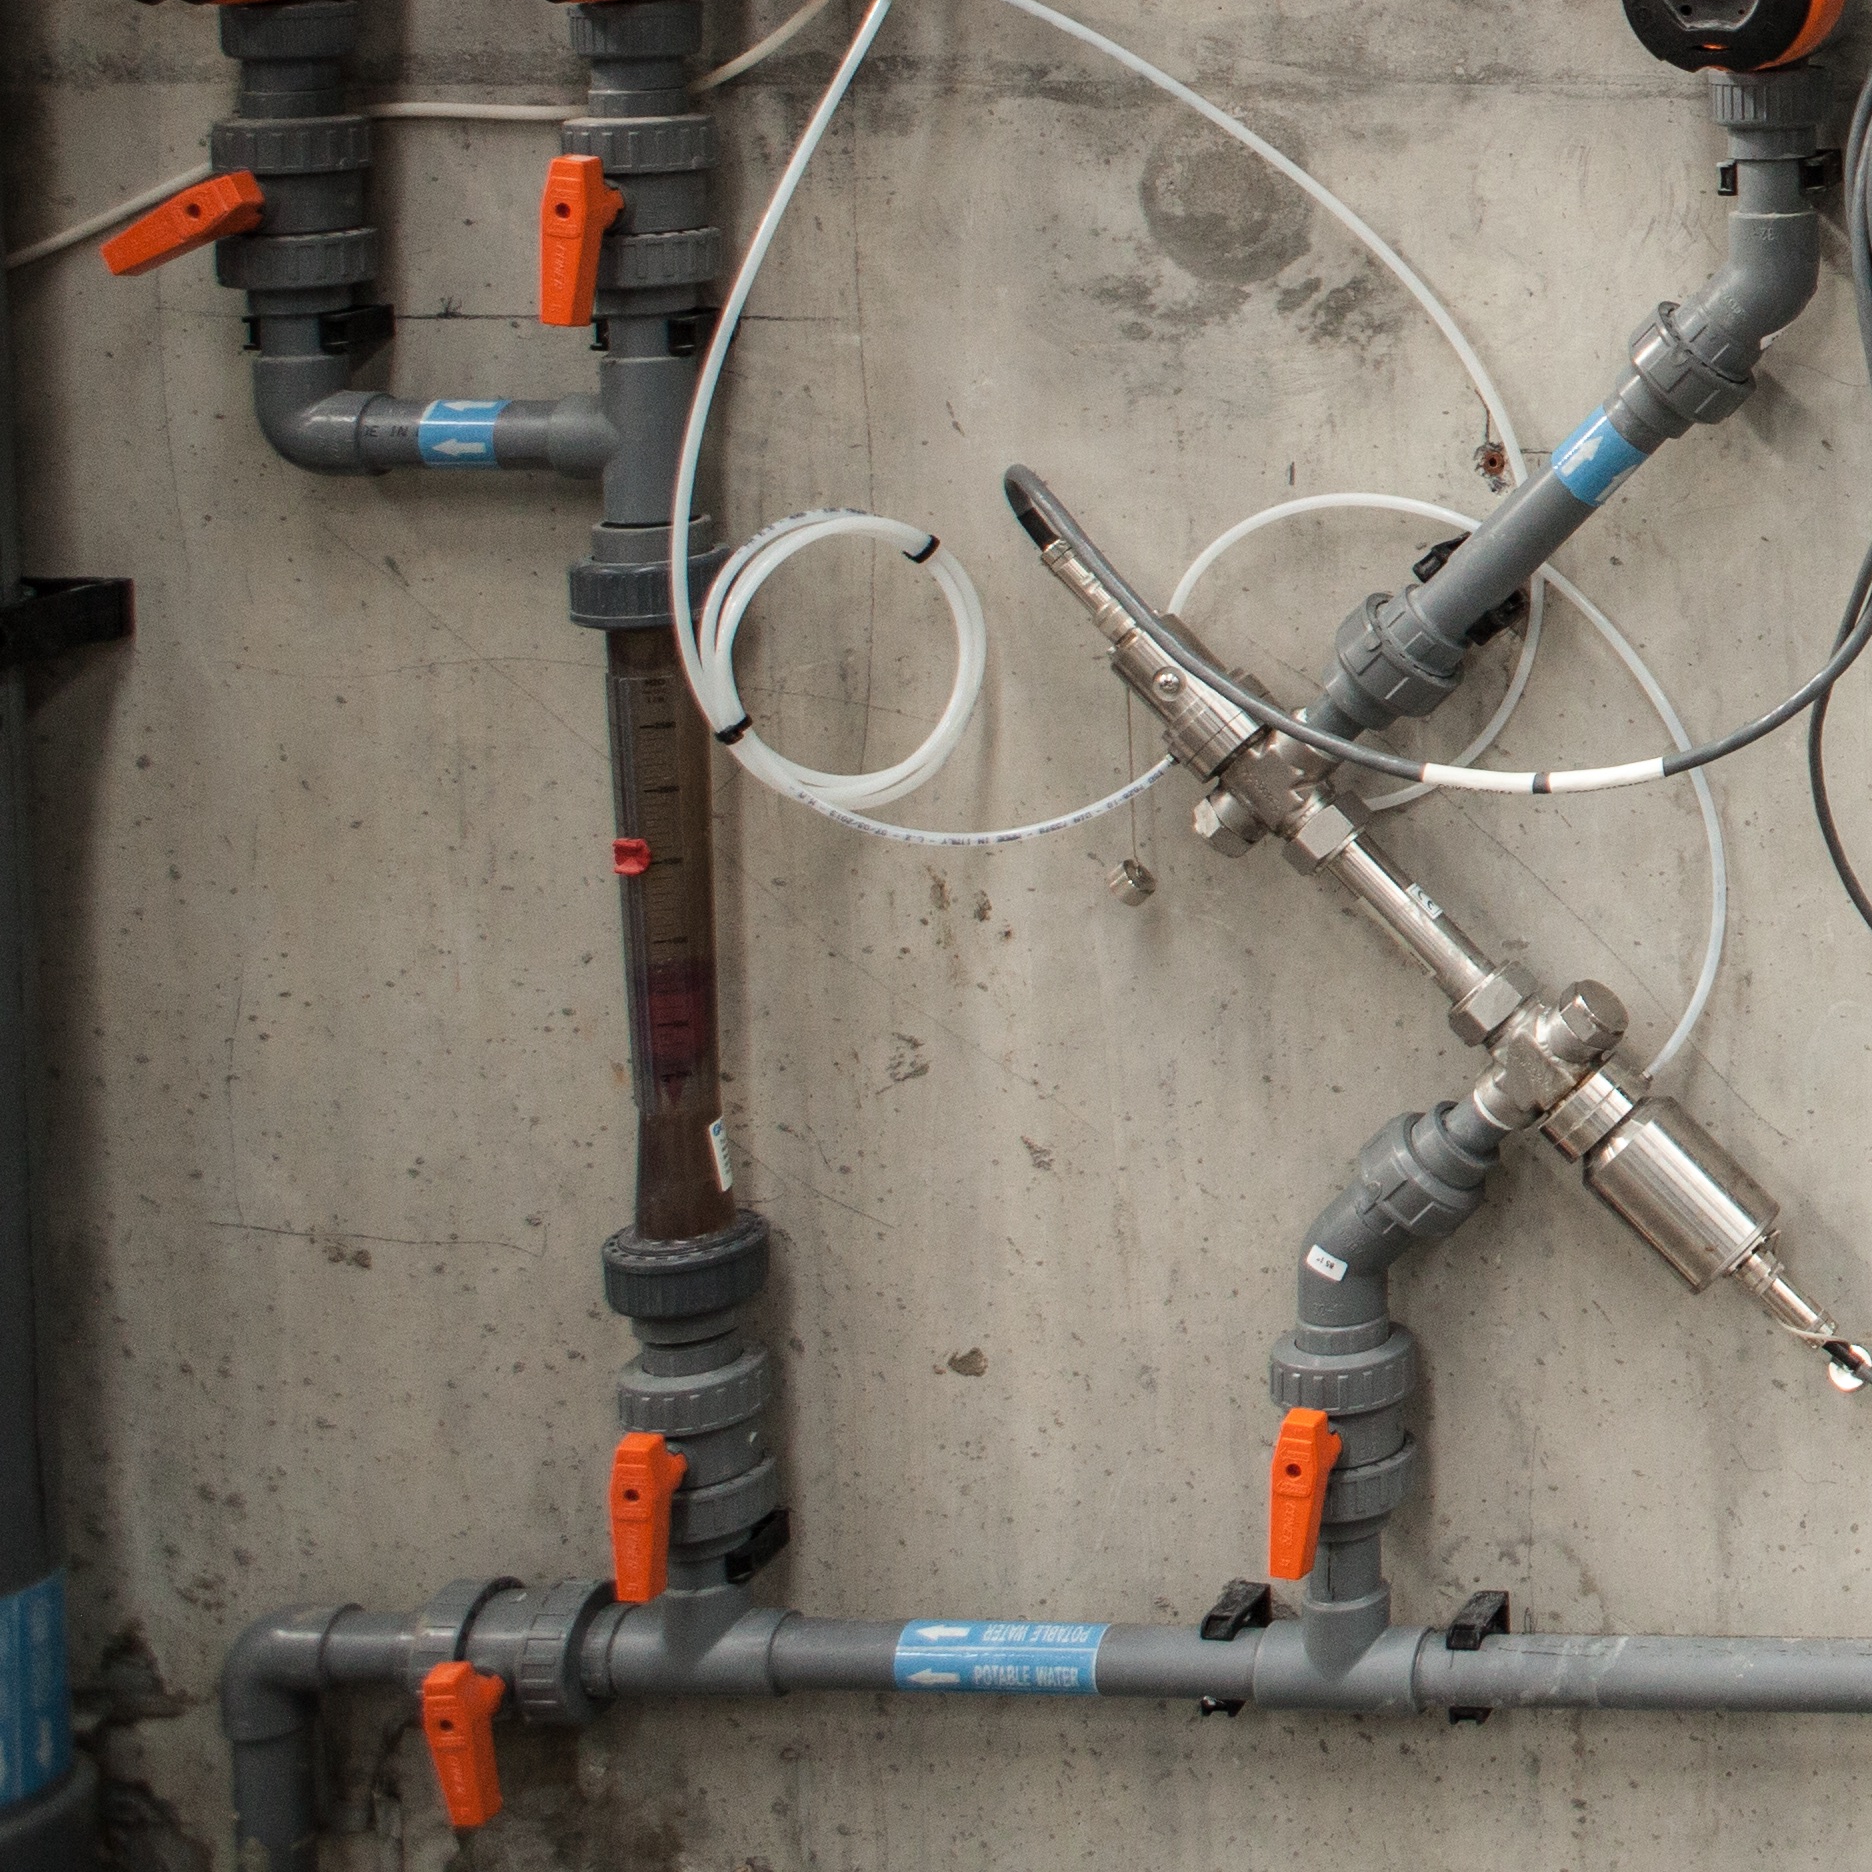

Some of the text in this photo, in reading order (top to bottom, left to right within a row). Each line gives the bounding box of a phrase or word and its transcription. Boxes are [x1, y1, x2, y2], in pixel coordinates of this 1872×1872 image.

[981, 1624, 1092, 1643] POTABLE WATER
[972, 1664, 1079, 1688] POTABLE WATER
